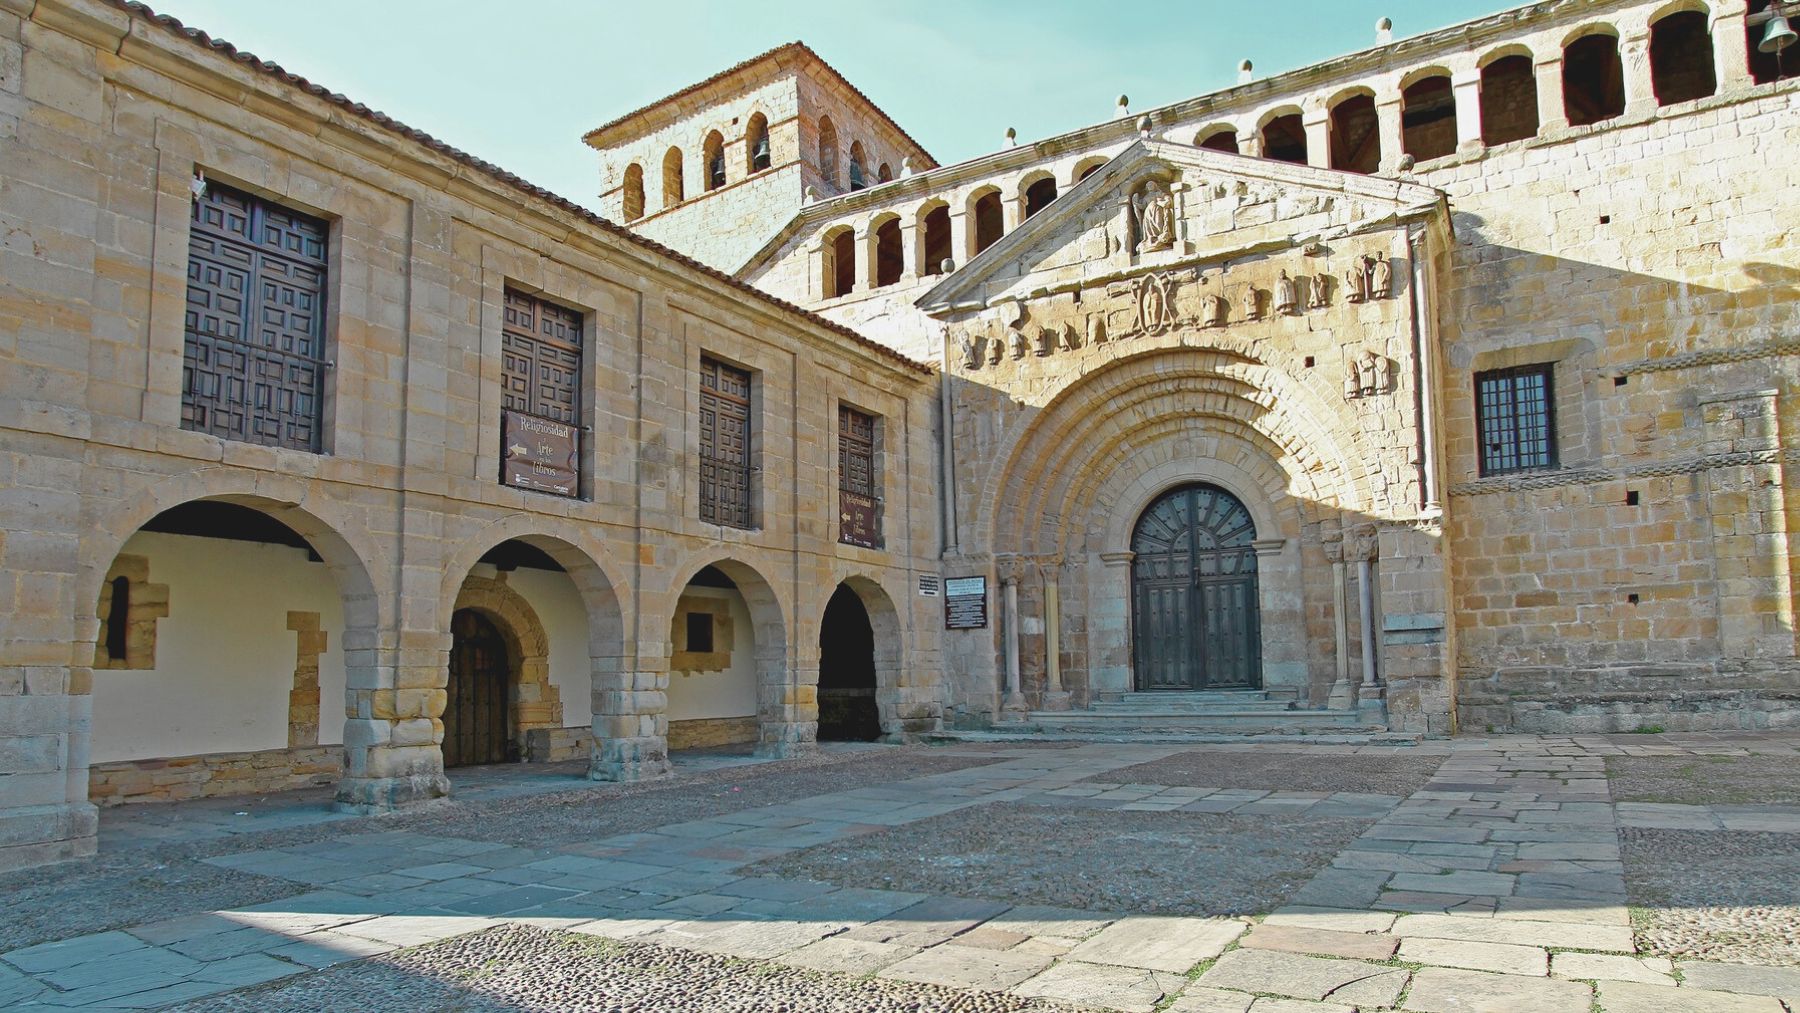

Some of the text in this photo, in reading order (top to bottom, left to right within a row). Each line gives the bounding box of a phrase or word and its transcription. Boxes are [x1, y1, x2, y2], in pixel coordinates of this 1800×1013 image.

[520, 416, 569, 439] Religiosidad
[536, 441, 553, 456] Arte
[532, 461, 556, 477] Libros
[846, 493, 871, 508] Religiosidad
